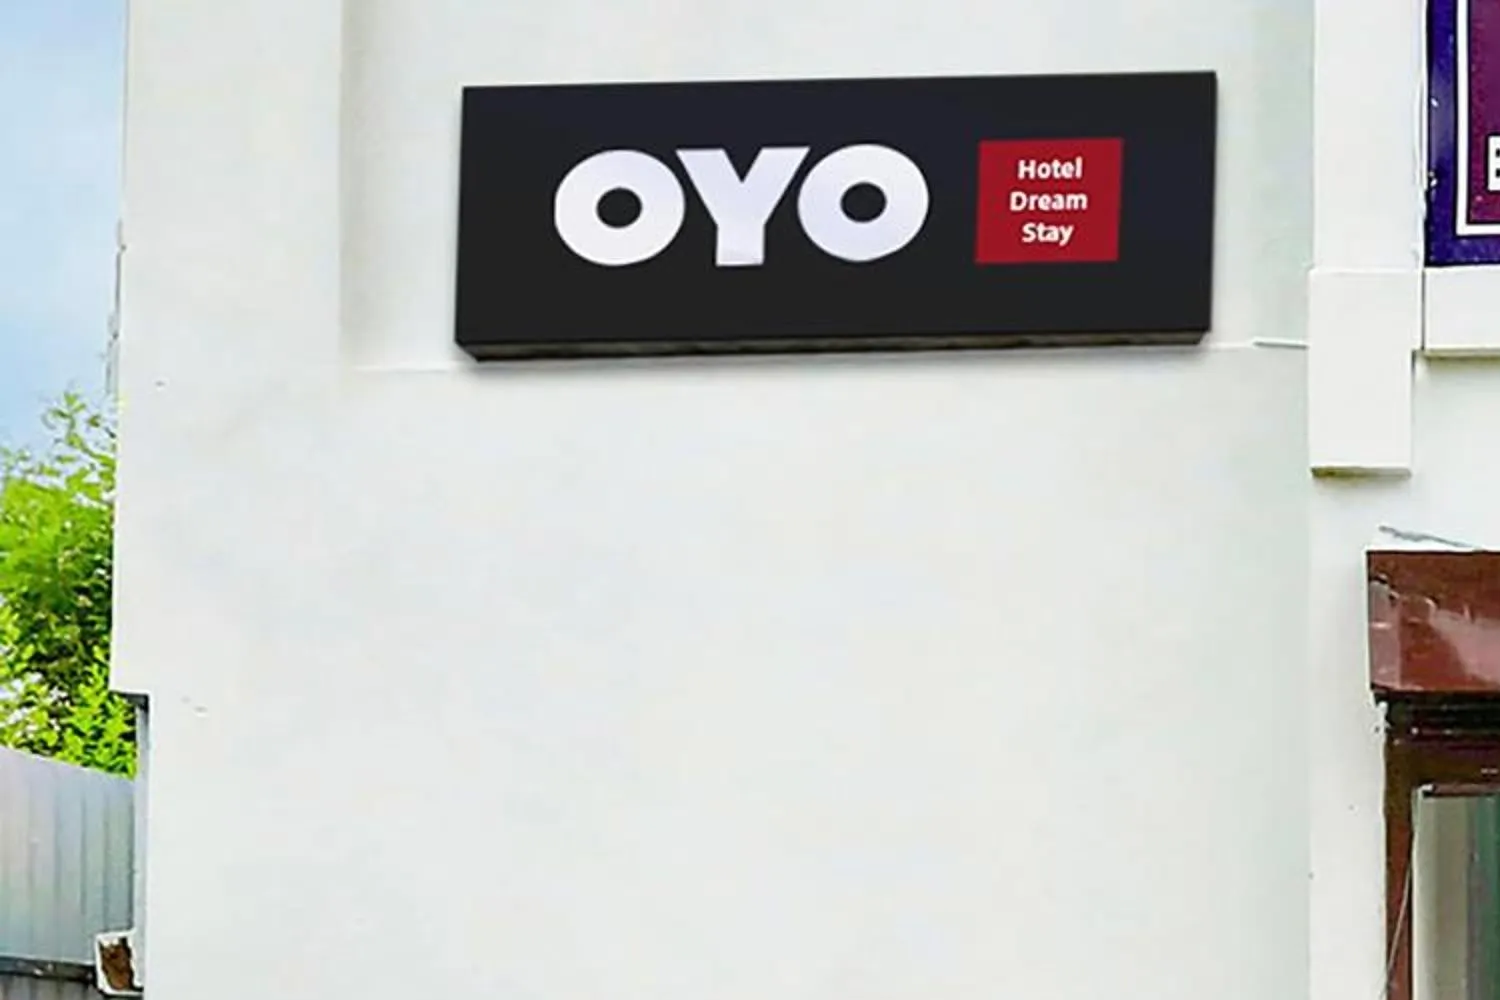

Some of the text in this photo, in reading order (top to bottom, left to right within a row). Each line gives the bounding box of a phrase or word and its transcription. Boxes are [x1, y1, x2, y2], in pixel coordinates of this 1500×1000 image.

[1017, 156, 1083, 180] Hotel
[553, 143, 930, 267] OYO
[1009, 190, 1089, 212] Dream
[1021, 221, 1075, 247] Stay
